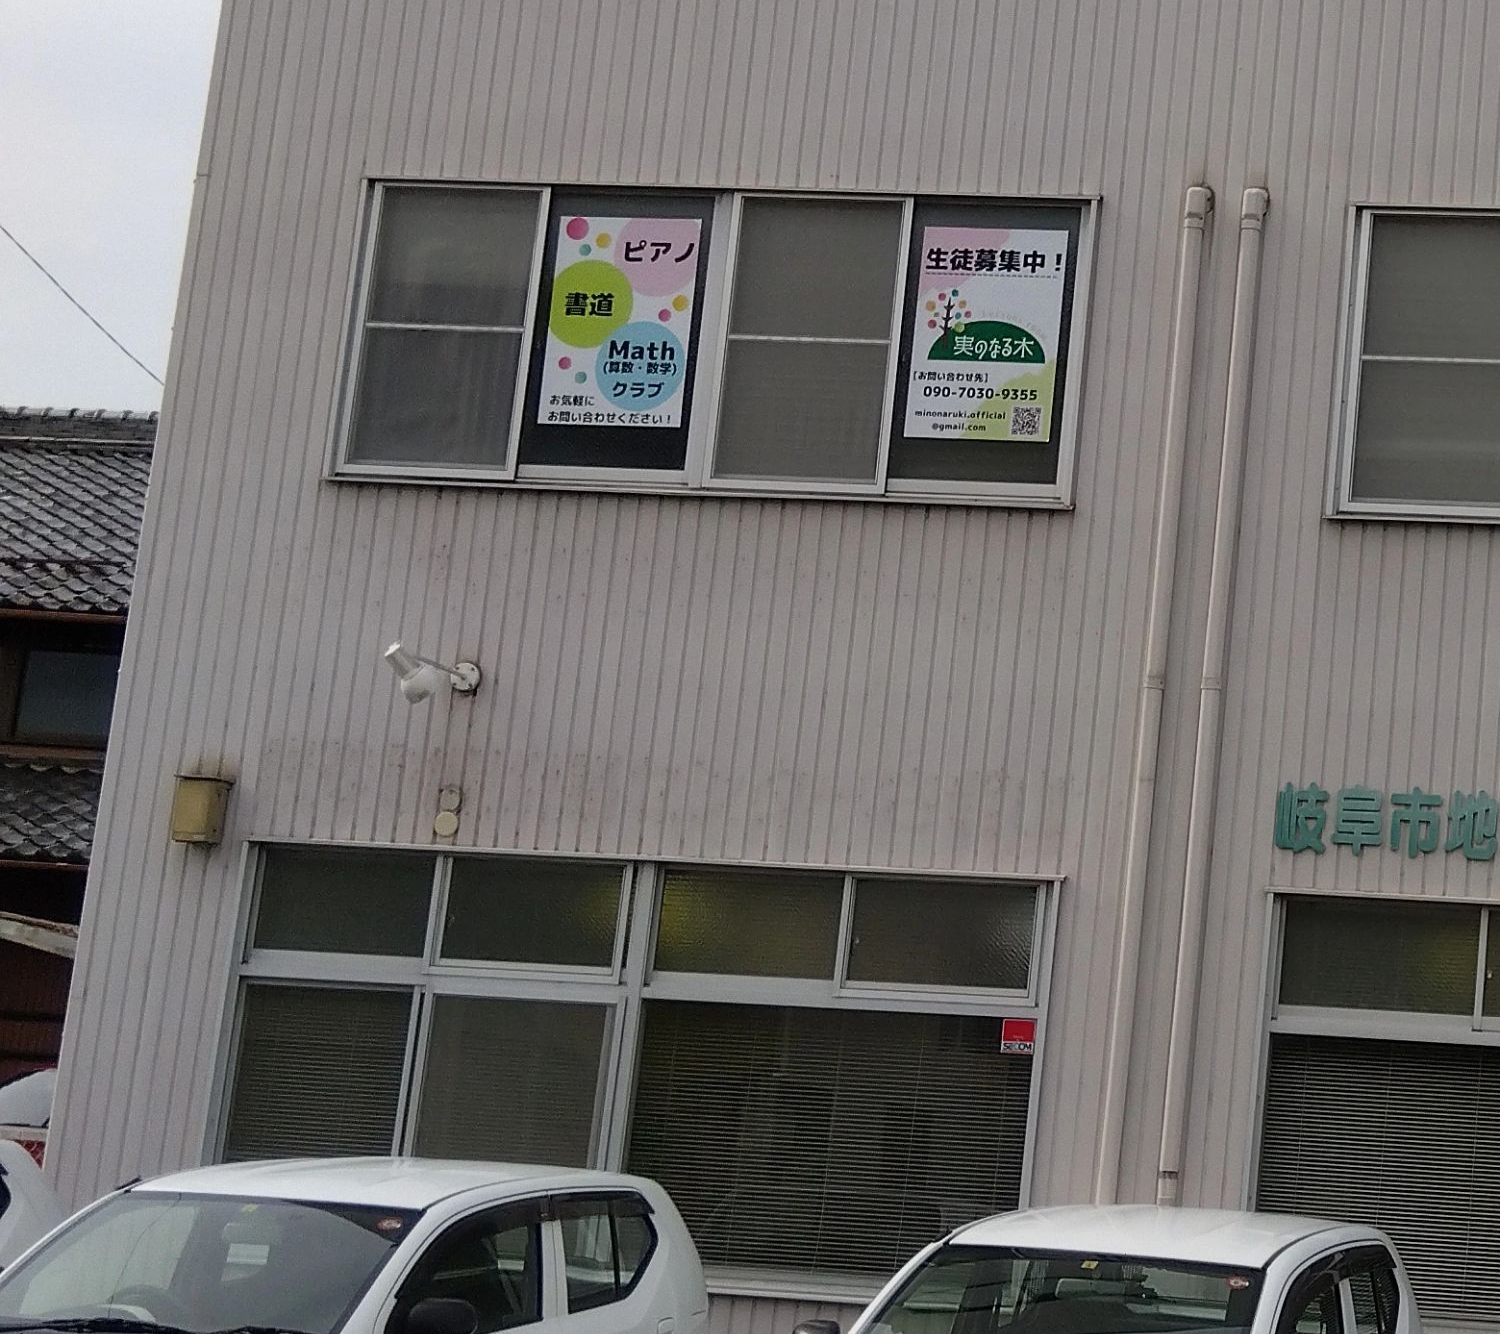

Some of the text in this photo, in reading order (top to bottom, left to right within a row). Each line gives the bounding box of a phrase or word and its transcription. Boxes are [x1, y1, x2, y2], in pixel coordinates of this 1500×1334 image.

[625, 240, 695, 263] ピアノ
[925, 247, 1063, 274] 生徒募集中！
[565, 292, 614, 317] 書道
[608, 340, 675, 361] Math
[953, 335, 1035, 360] 実のなる木
[612, 382, 665, 398] クラブ
[923, 385, 1037, 401] 090-7030-9355
[549, 395, 595, 407] お気軽に
[931, 422, 986, 433] @gmail.com
